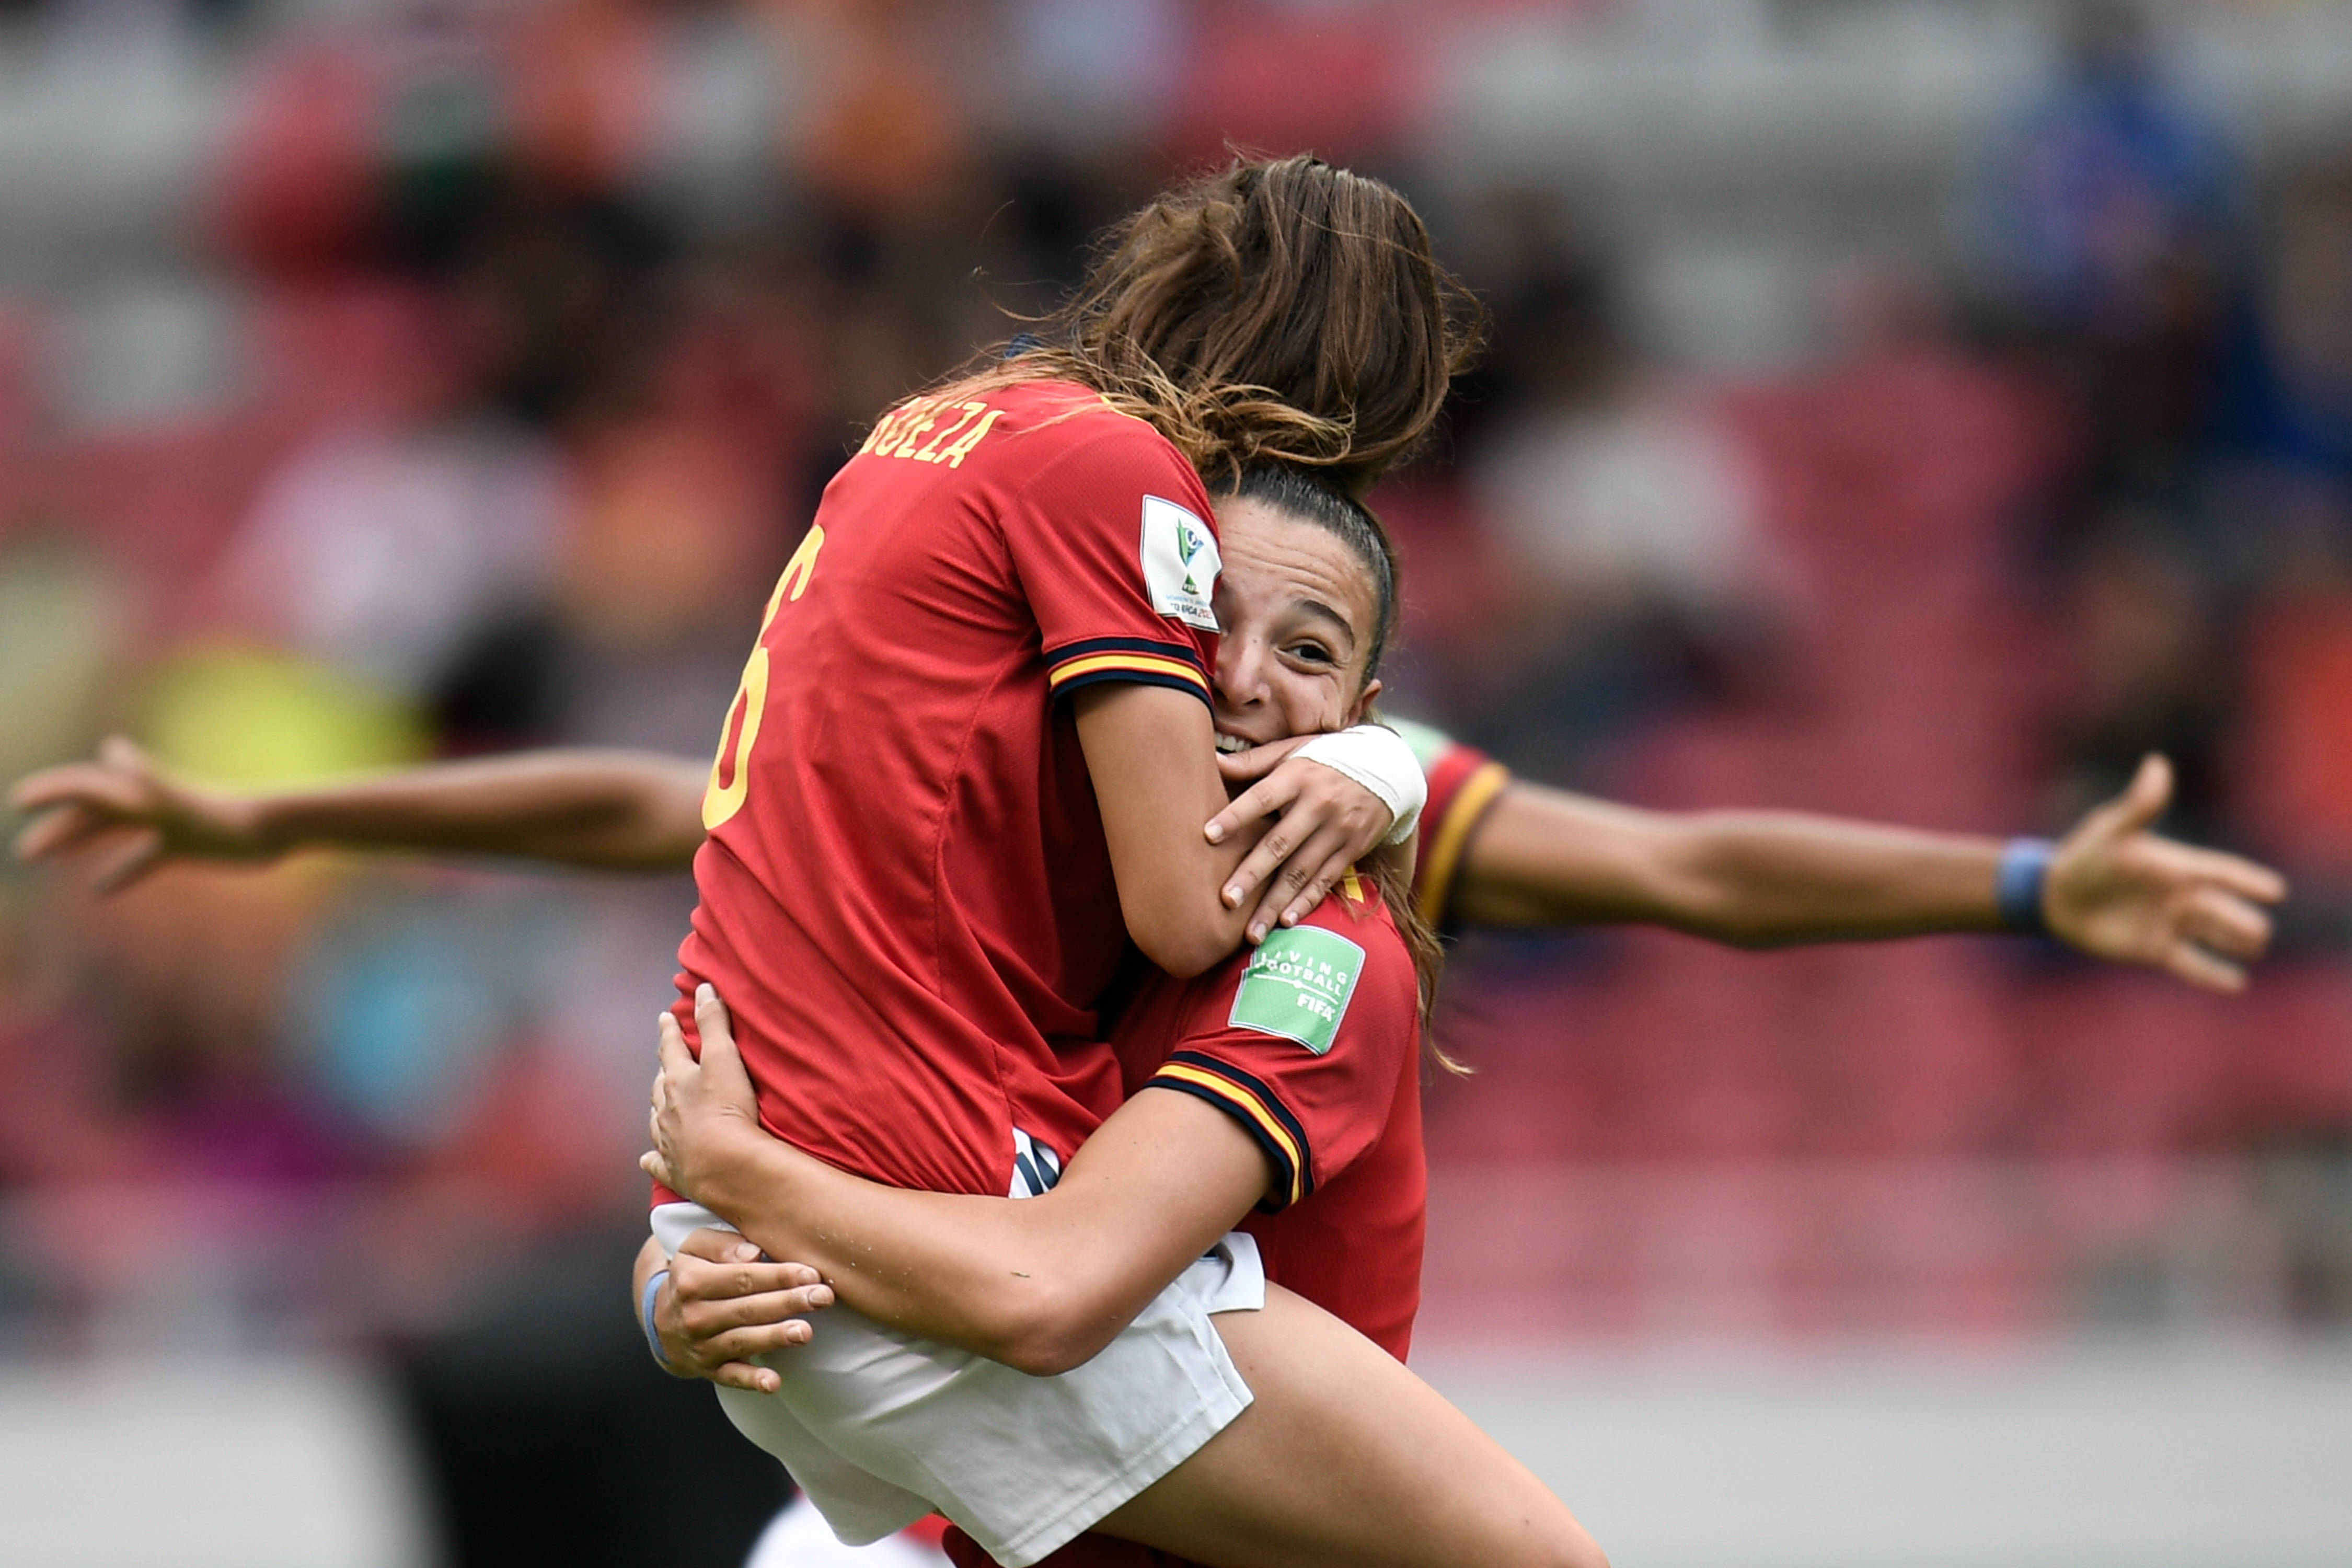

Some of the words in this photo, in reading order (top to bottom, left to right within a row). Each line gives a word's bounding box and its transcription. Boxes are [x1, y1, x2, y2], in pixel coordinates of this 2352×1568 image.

[702, 524, 825, 830] 6
[1254, 960, 1341, 996] OOTBALL
[1297, 993, 1335, 1021] FIFA
